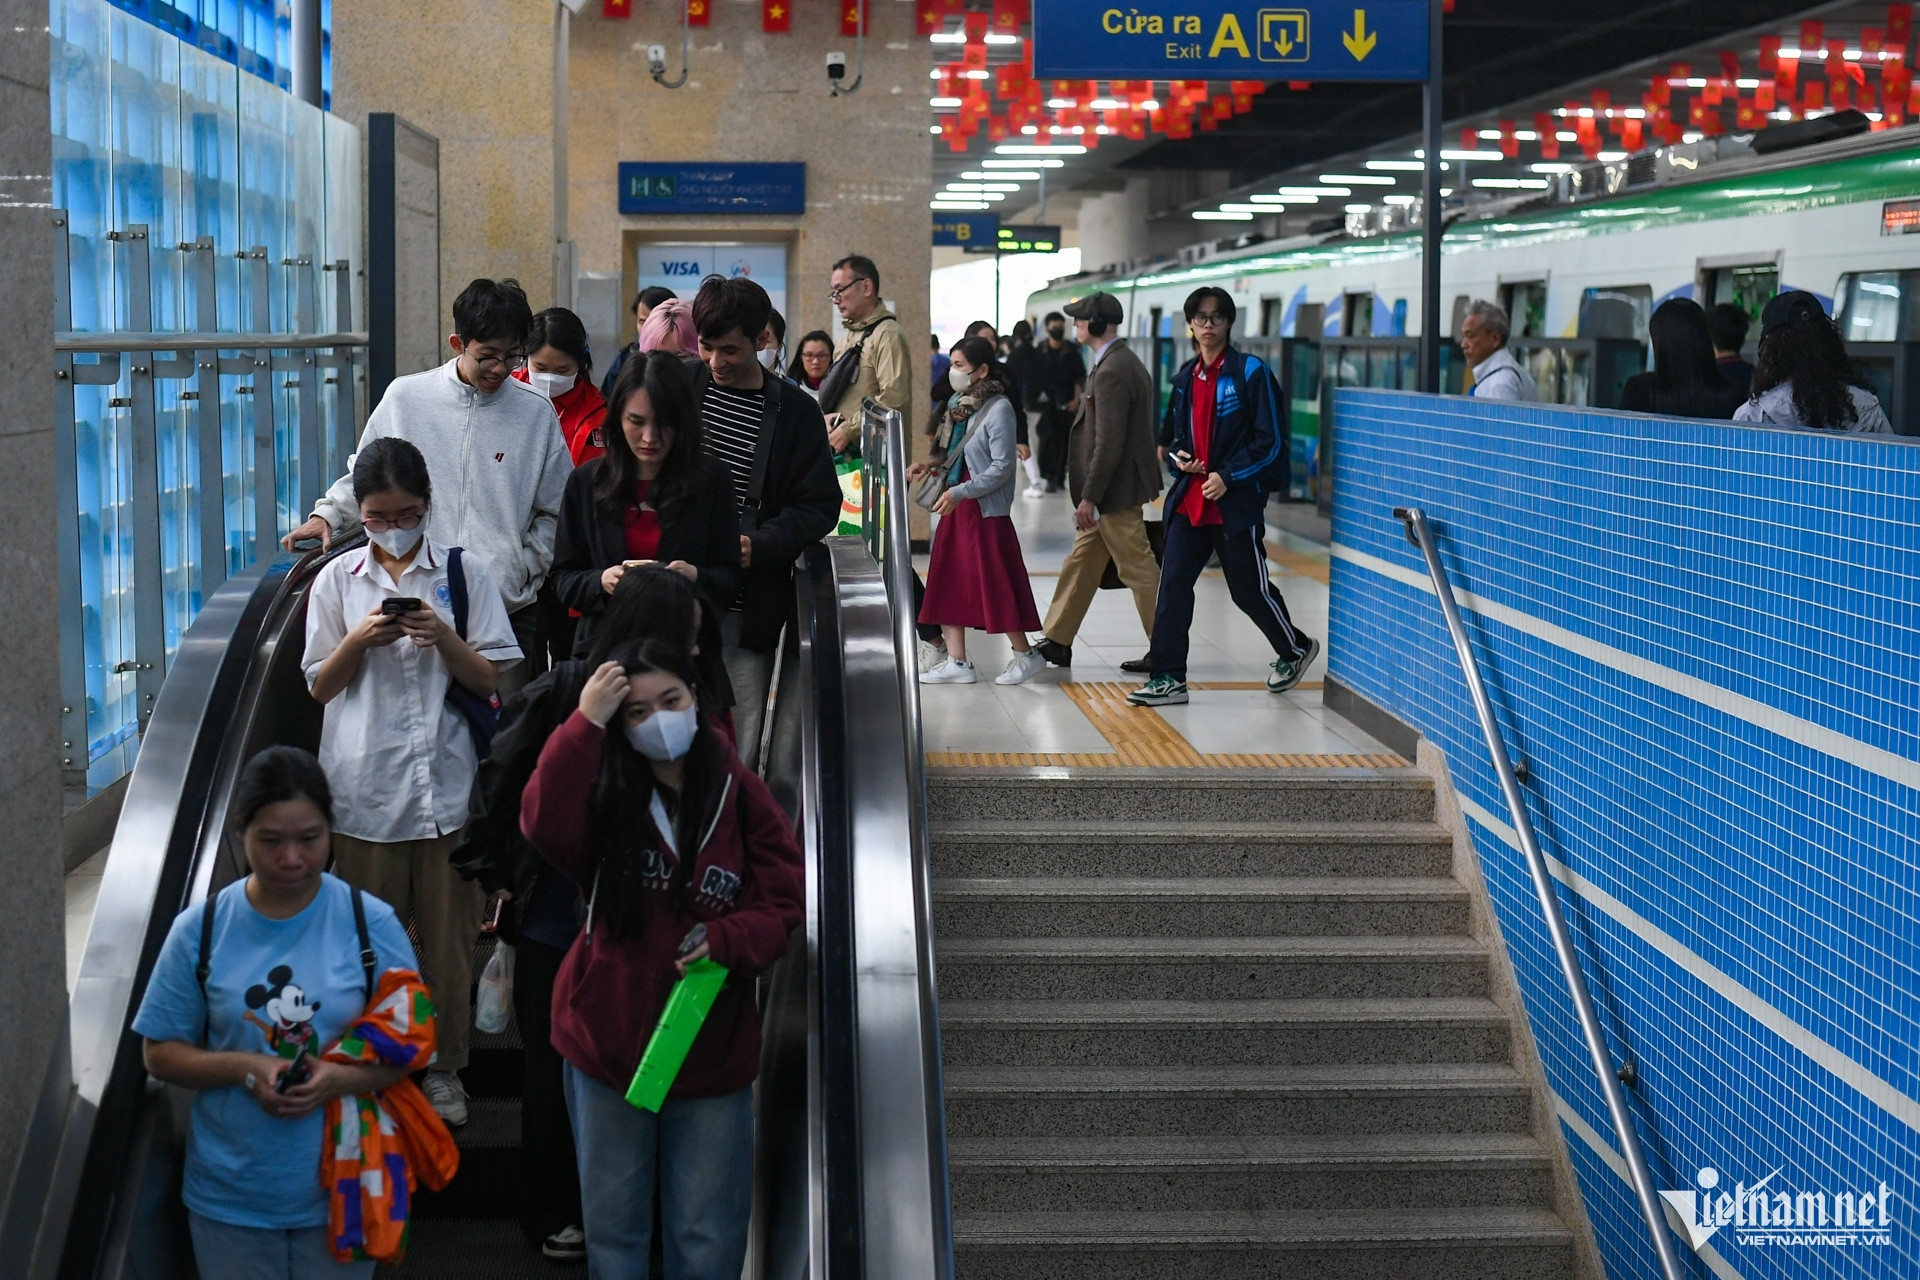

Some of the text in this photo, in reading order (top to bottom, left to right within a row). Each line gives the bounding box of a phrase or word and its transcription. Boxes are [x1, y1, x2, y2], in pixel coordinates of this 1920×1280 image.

[1102, 8, 1202, 35] Cửa ra
[1207, 13, 1251, 58] A
[1165, 42, 1202, 59] Exit
[956, 223, 971, 240] B
[661, 261, 700, 276] VISA
